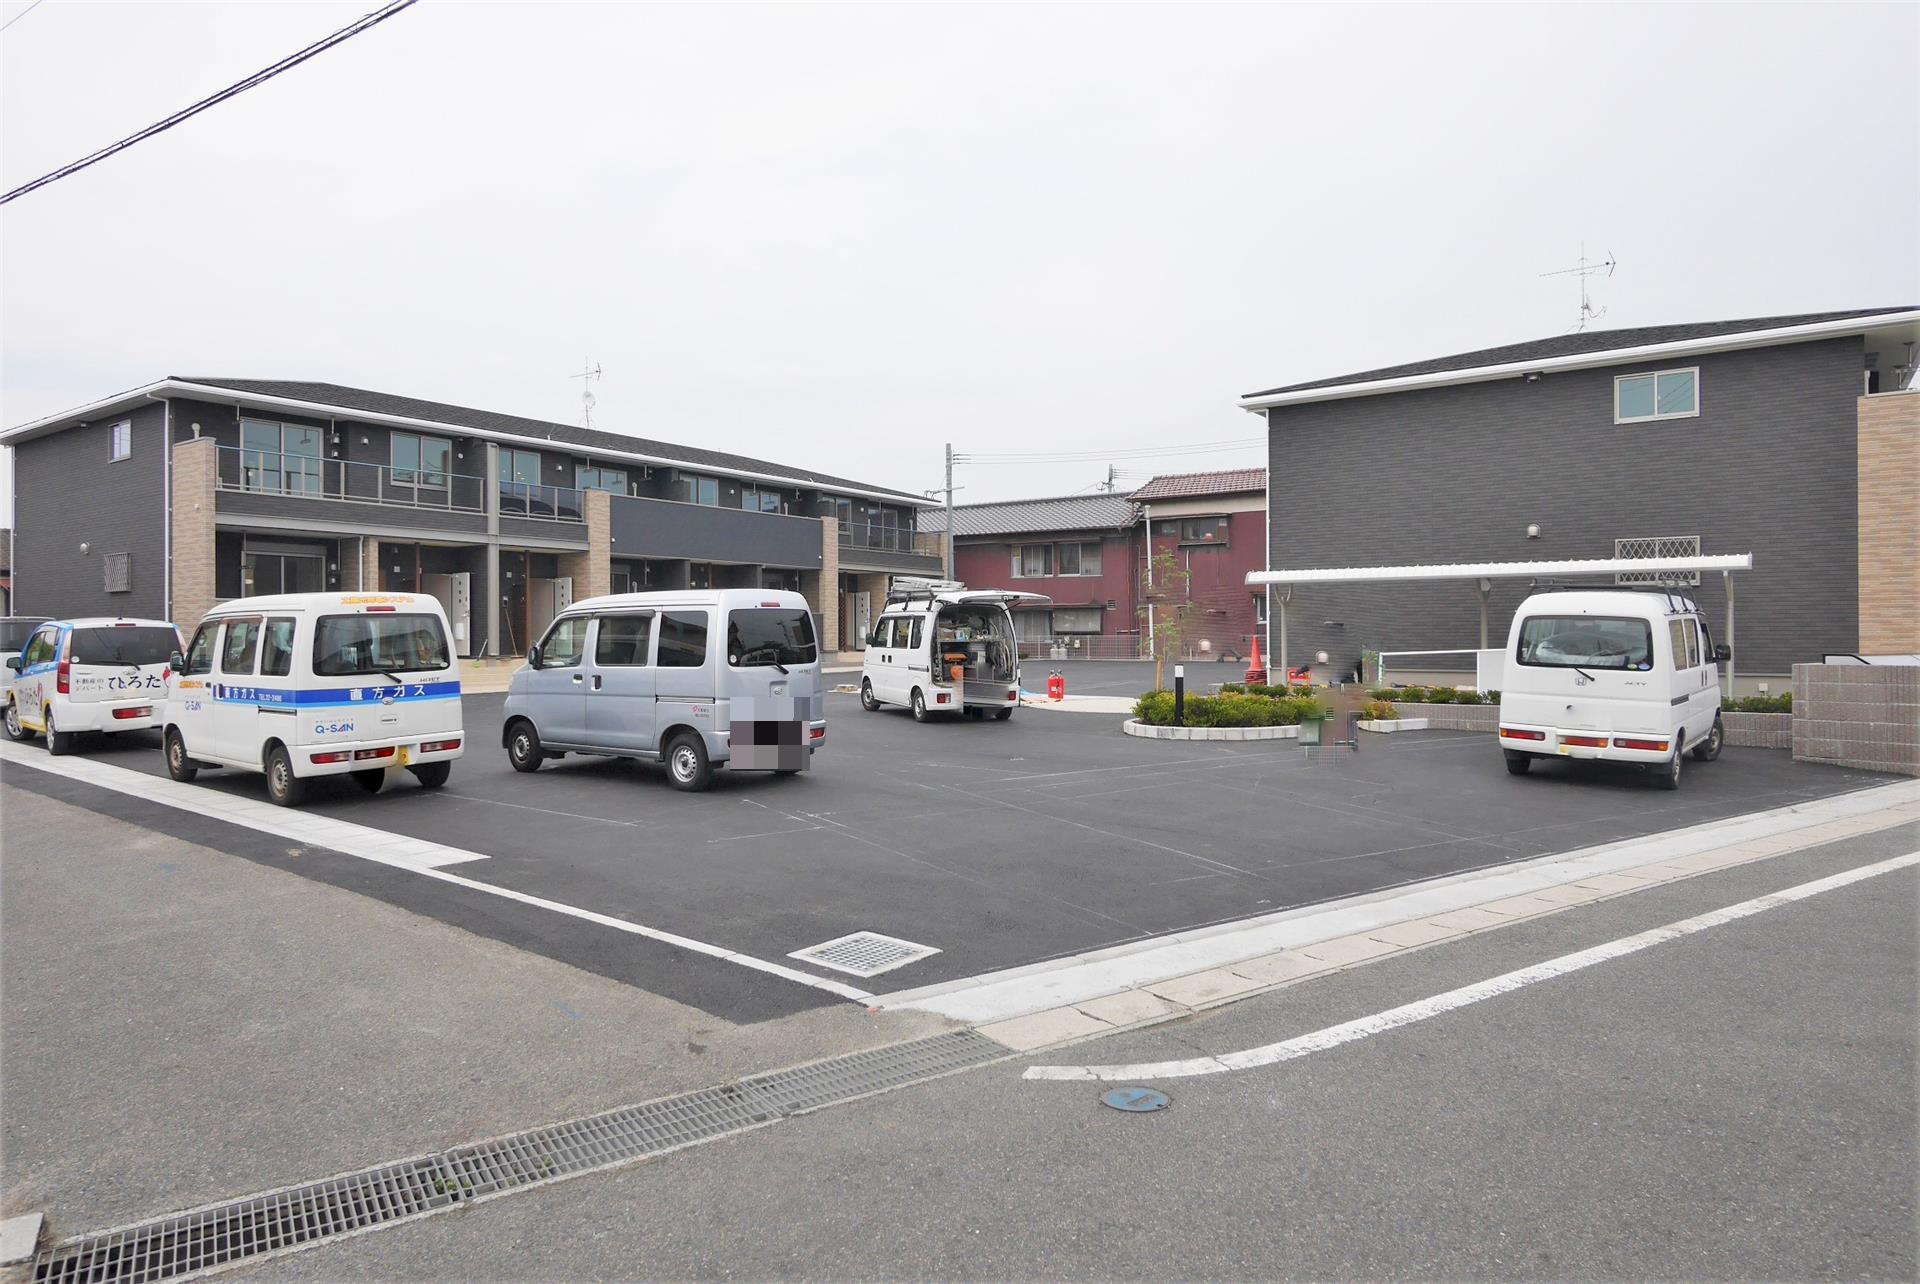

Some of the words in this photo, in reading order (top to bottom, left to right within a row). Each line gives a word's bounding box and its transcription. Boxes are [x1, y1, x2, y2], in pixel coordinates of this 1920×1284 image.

[108, 674, 161, 690] ひろた
[350, 684, 425, 701] 直方ガス
[315, 722, 354, 735] Q-SAN
